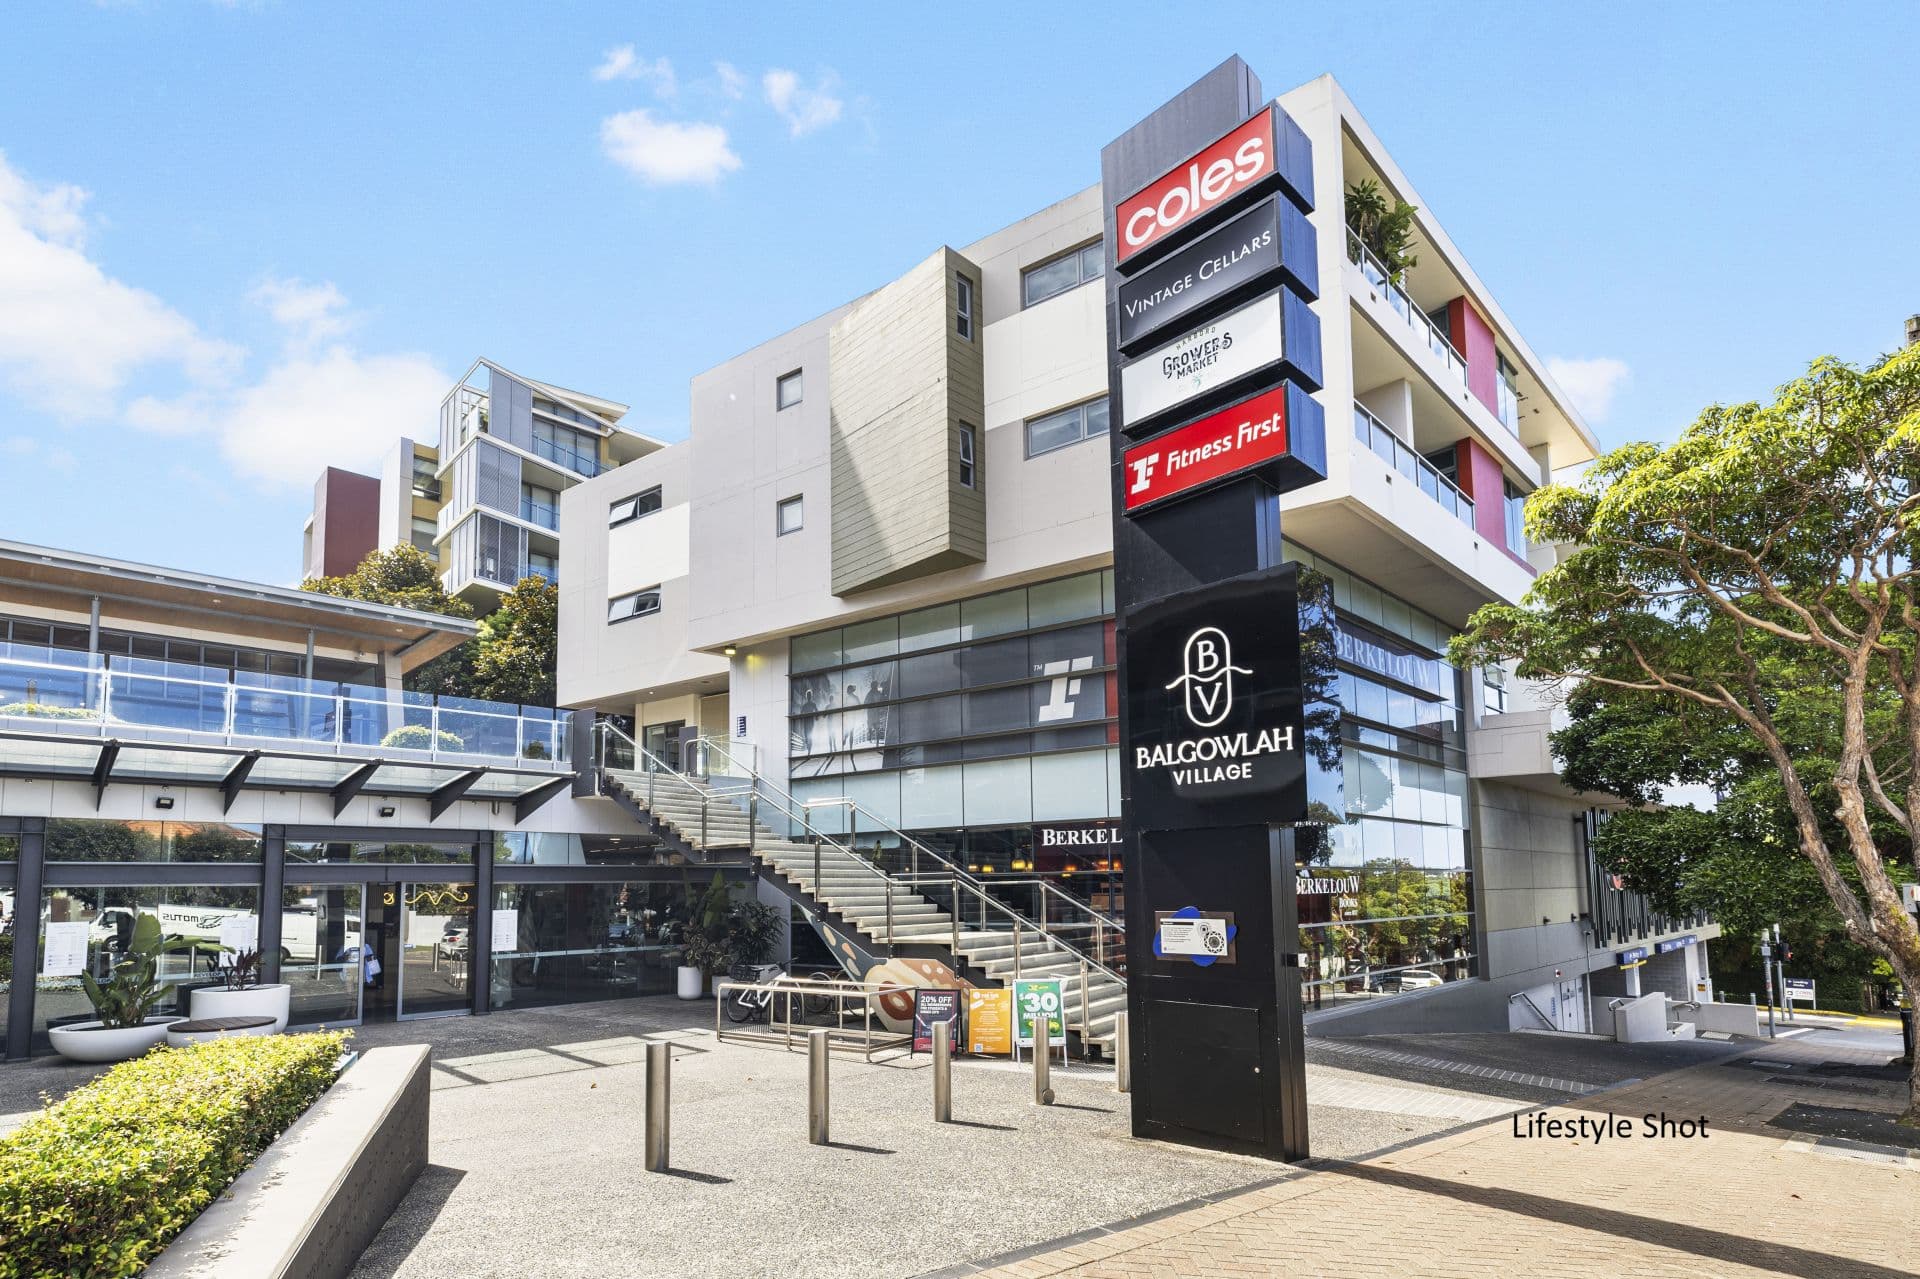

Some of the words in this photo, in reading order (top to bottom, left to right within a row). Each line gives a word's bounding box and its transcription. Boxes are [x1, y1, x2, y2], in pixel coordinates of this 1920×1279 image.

[1125, 137, 1265, 246] coles
[1125, 274, 1193, 318] VINTAGE
[1199, 230, 1271, 280] CELLARS
[1177, 352, 1219, 380] MARKET
[1166, 435, 1232, 476] Fitness
[1236, 413, 1281, 450] First
[1136, 726, 1294, 769] BALGOWLAH
[1172, 762, 1252, 786] VILLAGE
[920, 995, 937, 1003] 20%
[938, 996, 952, 1004] OFF
